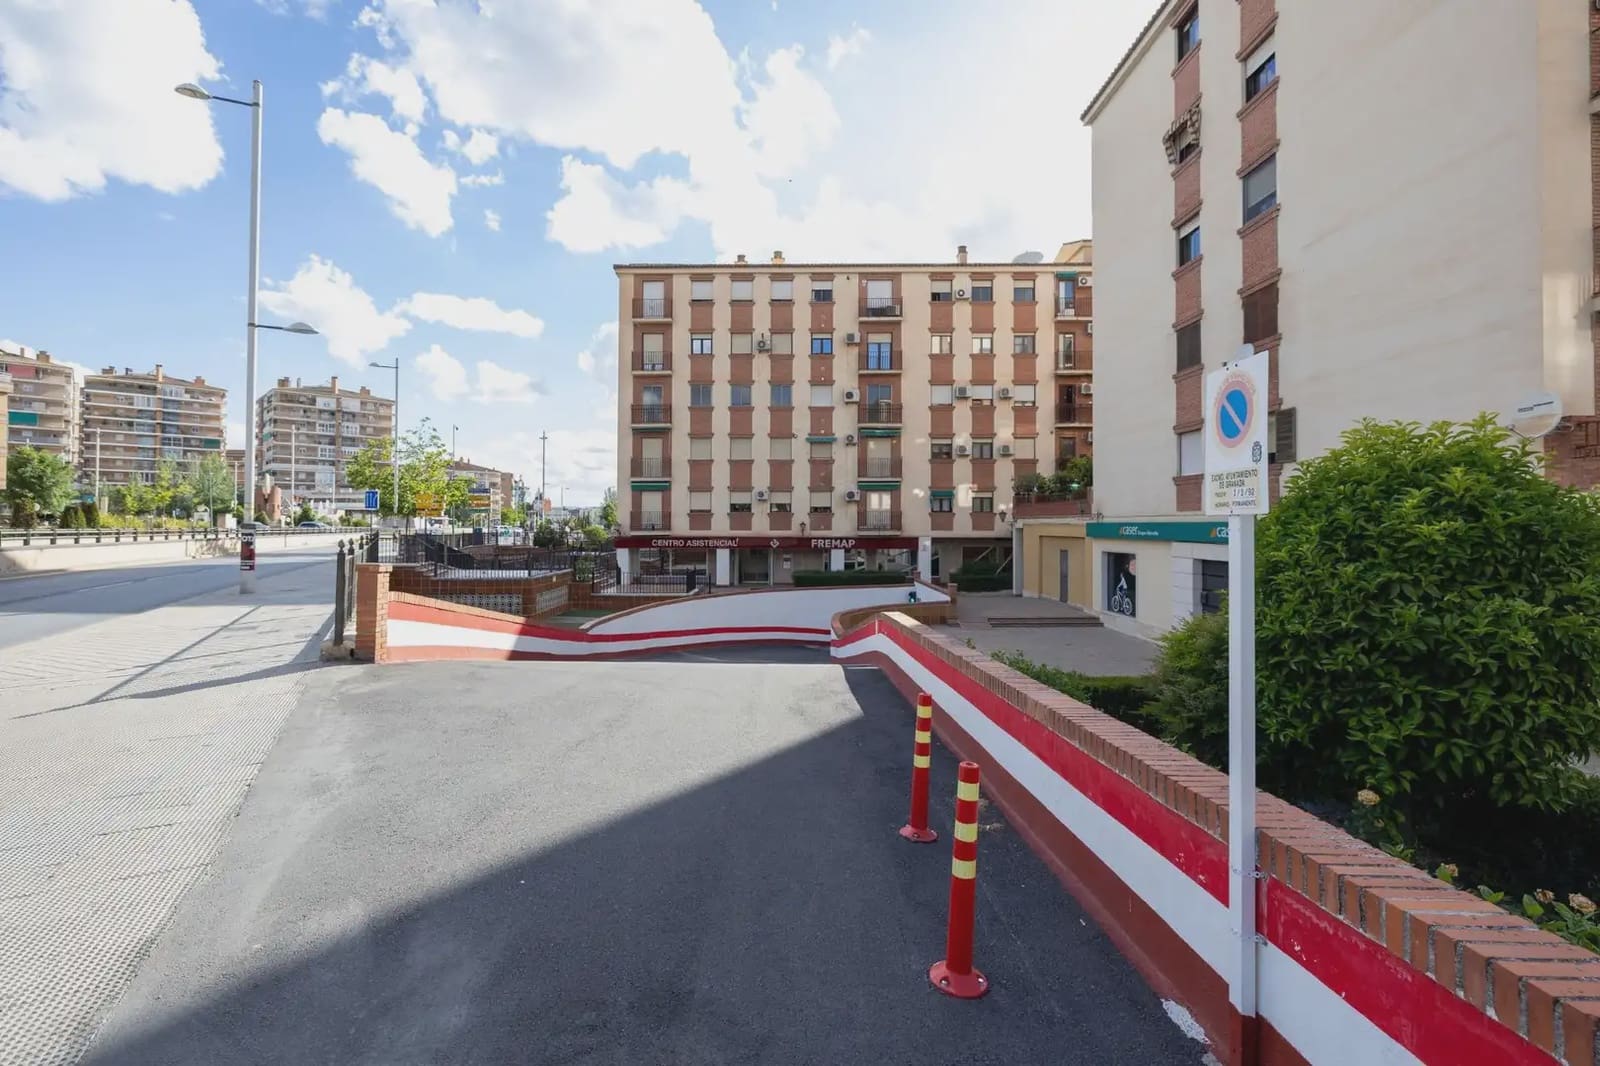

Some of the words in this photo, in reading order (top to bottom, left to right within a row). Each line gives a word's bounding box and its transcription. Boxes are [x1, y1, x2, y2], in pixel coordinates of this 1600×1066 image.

[651, 539, 684, 547] CENTRO
[686, 539, 737, 547] ASISTENCIAL
[811, 539, 856, 549] FREMAP
